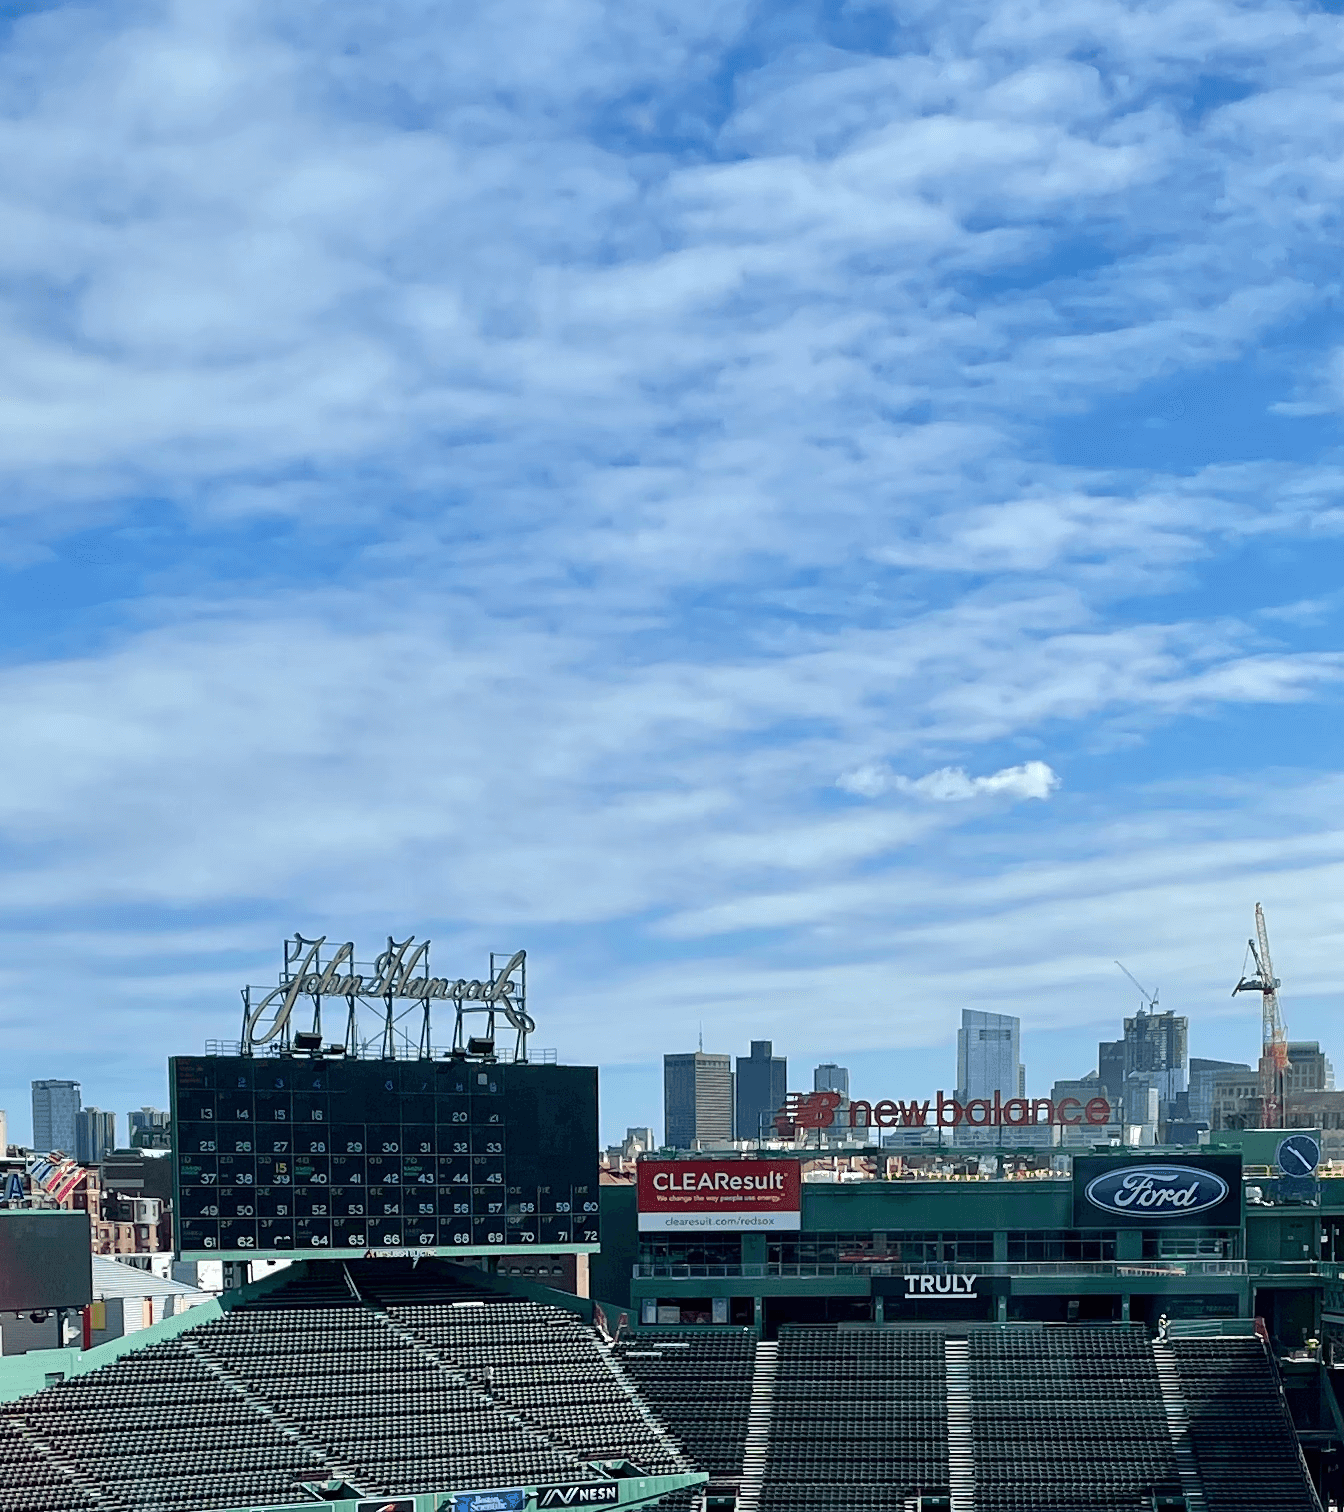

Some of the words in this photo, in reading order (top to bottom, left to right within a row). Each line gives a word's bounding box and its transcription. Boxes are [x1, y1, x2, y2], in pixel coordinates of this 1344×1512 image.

[246, 932, 364, 1045] John
[364, 935, 534, 1033] Hancock
[200, 1108, 213, 1120] 13
[236, 1109, 250, 1120] 14
[274, 1109, 286, 1121] 15
[311, 1110, 323, 1121] 16
[452, 1112, 468, 1123] 20
[849, 1098, 931, 1128] new
[935, 1089, 1112, 1127] balance
[199, 1141, 216, 1152] 25
[235, 1141, 252, 1152] 26
[273, 1142, 288, 1153] 27
[310, 1142, 326, 1153] 28
[346, 1142, 363, 1153] 29
[381, 1142, 399, 1153] 30
[419, 1142, 431, 1153] 31
[452, 1142, 468, 1153] 32
[486, 1142, 503, 1153] 33
[200, 1173, 217, 1185] 37
[235, 1174, 253, 1185] 38
[309, 1174, 328, 1185] 40
[349, 1173, 361, 1184] 41
[382, 1173, 400, 1184] 42
[417, 1173, 435, 1184] 43
[452, 1173, 469, 1184] 44
[486, 1173, 503, 1184] 45
[652, 1171, 784, 1191] CLEAResult
[1113, 1172, 1200, 1207] Ford
[199, 1205, 219, 1216] 49
[236, 1205, 254, 1216] 50
[276, 1204, 288, 1216] 51
[311, 1204, 328, 1216] 52
[347, 1204, 364, 1215] 53
[383, 1203, 399, 1215] 54
[418, 1203, 434, 1214] 55
[453, 1203, 469, 1214] 56
[487, 1202, 503, 1214] 57
[519, 1202, 535, 1213] 58
[555, 1202, 571, 1213] 59
[582, 1201, 599, 1212] 60
[203, 1236, 217, 1248] 61
[237, 1236, 255, 1247] 62
[310, 1235, 329, 1247] 64
[348, 1234, 365, 1246] 65
[383, 1234, 401, 1245] 66
[419, 1233, 435, 1245] 67
[453, 1233, 470, 1244] 68
[487, 1232, 504, 1243] 69
[519, 1231, 535, 1242] 70
[557, 1231, 568, 1242] 71
[583, 1230, 598, 1241] 72
[903, 1273, 977, 1293] TRULY
[579, 1486, 616, 1502] NESN
